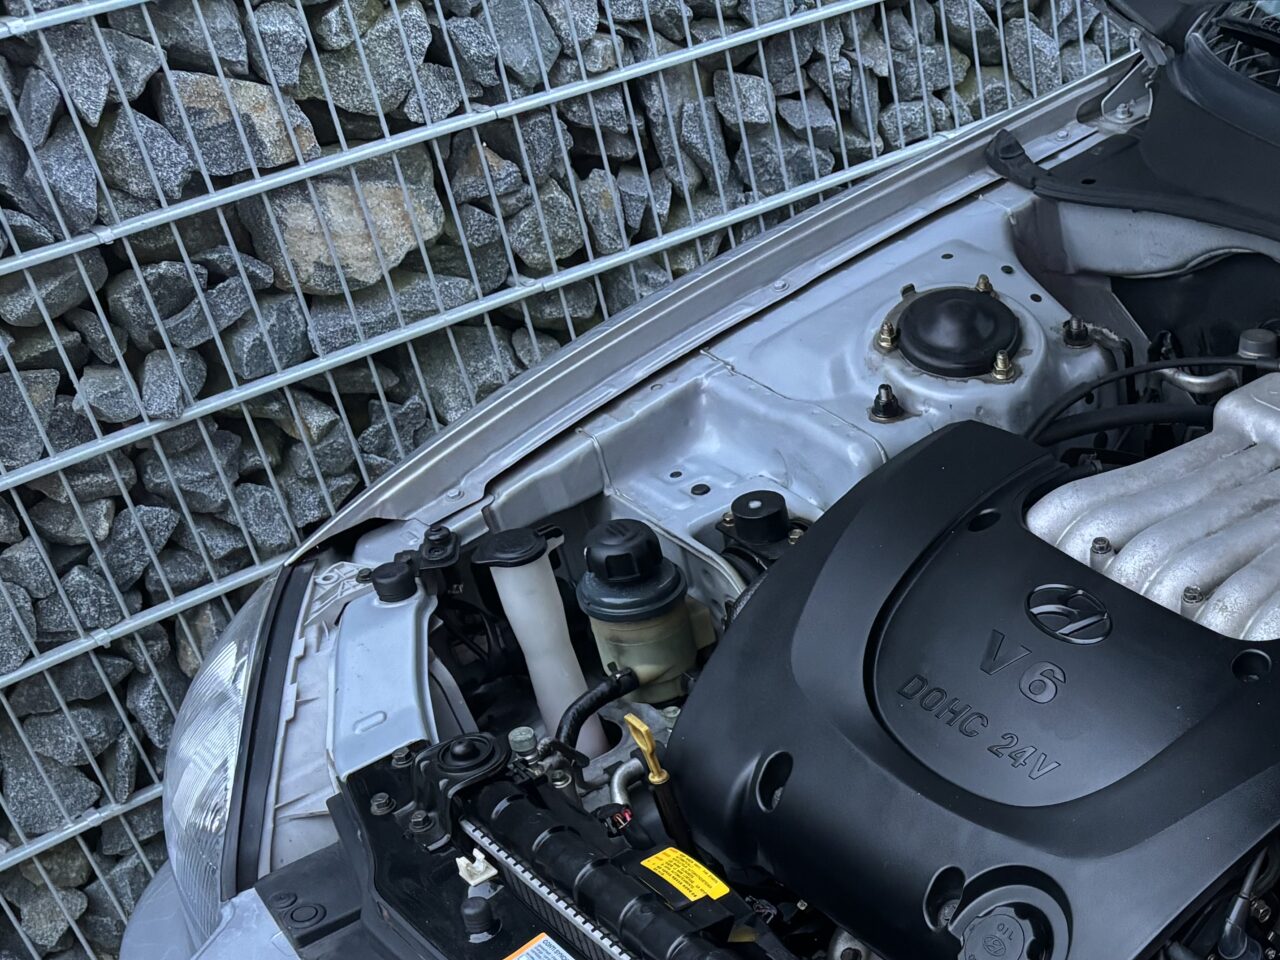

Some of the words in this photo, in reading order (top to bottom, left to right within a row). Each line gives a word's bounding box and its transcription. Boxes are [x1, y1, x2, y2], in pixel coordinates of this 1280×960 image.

[896, 673, 989, 738] DOHC
[987, 732, 1062, 780] 24V
[997, 922, 1014, 941] OIL
